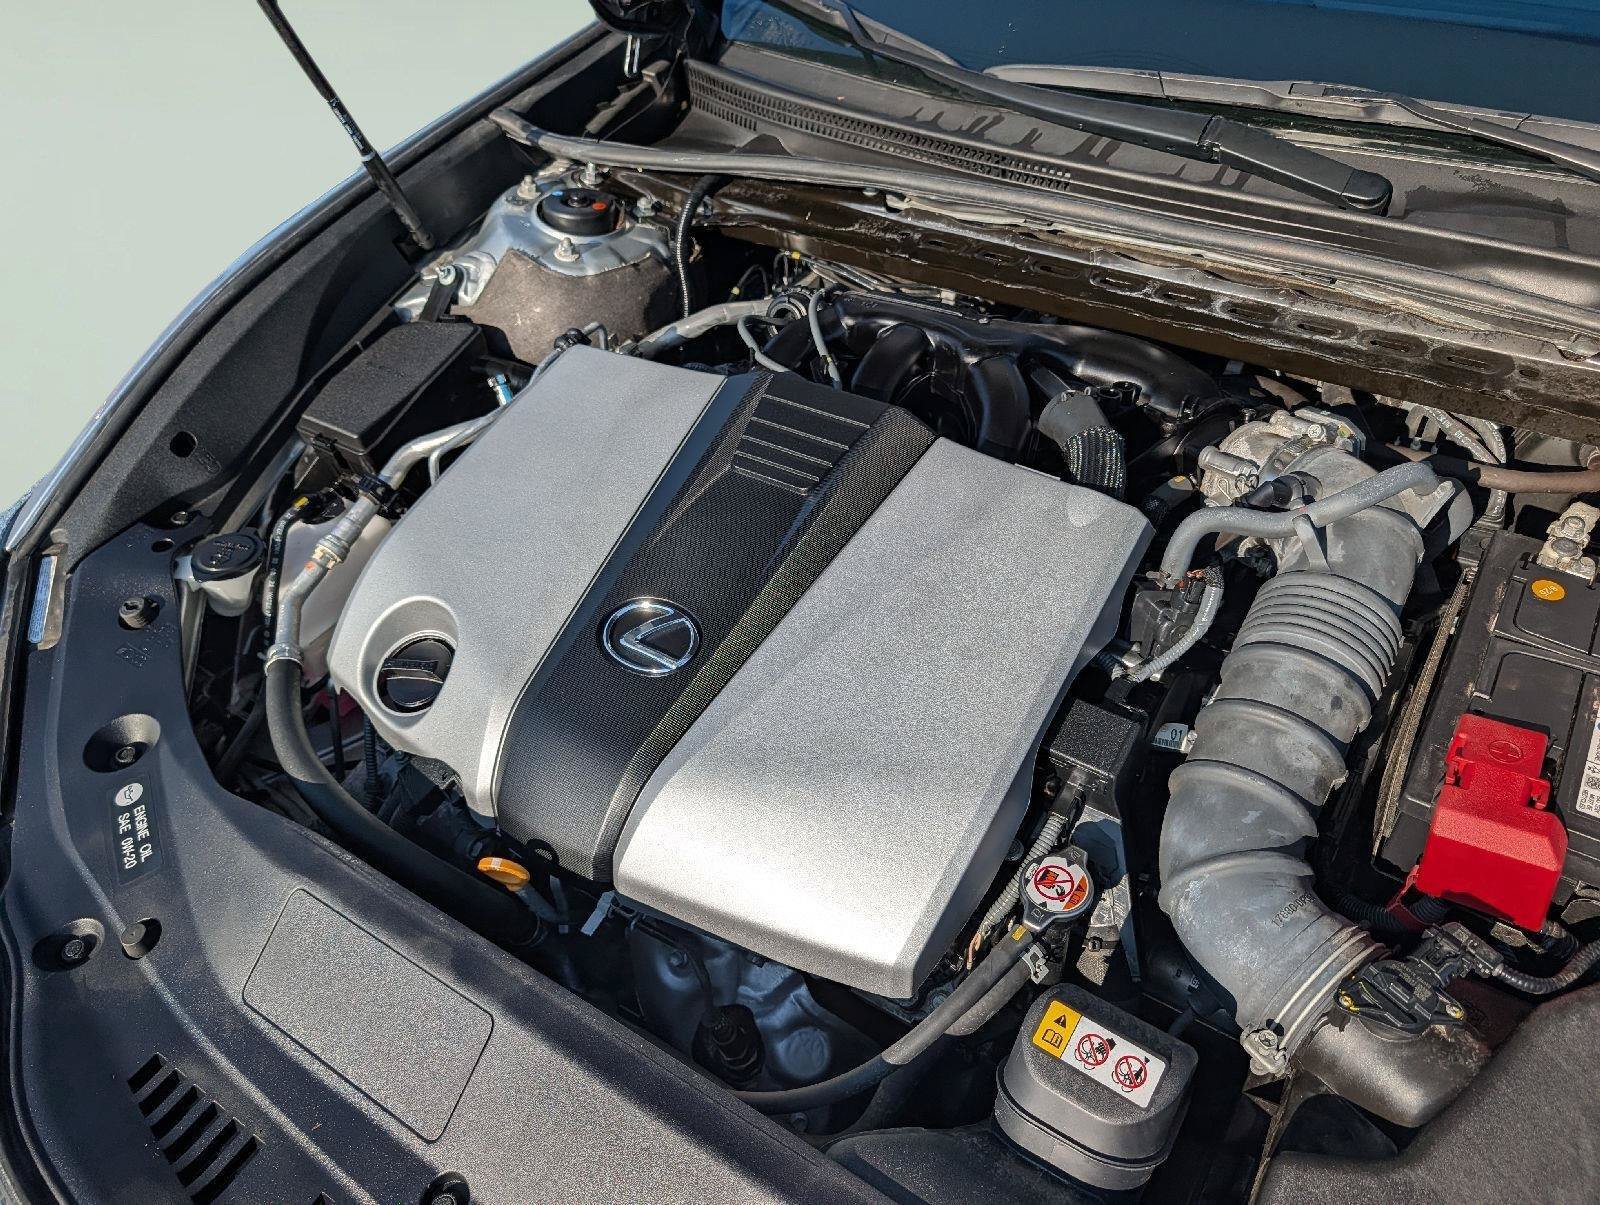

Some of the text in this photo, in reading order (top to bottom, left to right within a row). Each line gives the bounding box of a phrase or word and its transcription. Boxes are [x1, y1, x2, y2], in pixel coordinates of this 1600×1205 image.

[118, 812, 138, 869] SAE 0W-20
[134, 804, 153, 863] ENGINE OIL
